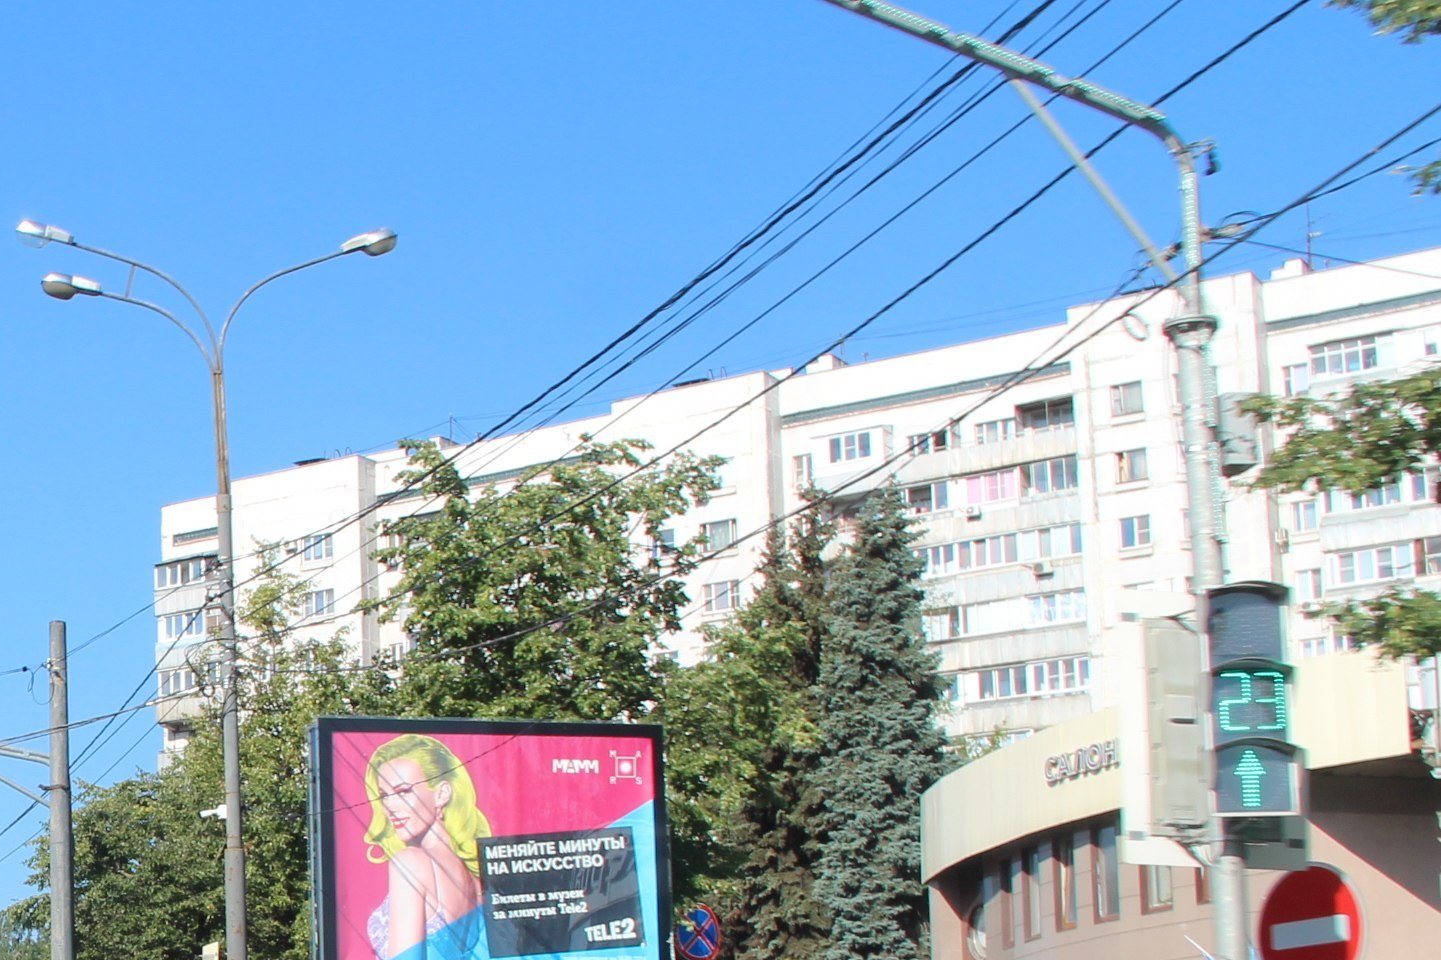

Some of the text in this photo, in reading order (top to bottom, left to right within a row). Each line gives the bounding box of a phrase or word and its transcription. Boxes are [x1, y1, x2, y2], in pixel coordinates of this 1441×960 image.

[1219, 672, 1286, 730] 23
[1045, 739, 1120, 783] САЛОН
[485, 836, 625, 859] МЕНЯЙТЕ МИНУТЫ
[487, 854, 604, 875] НА ИСКУССТВО
[491, 892, 536, 905] Билеты
[538, 893, 546, 901] в
[493, 902, 588, 919] за минуты Tele2
[584, 918, 637, 942] TELE2
